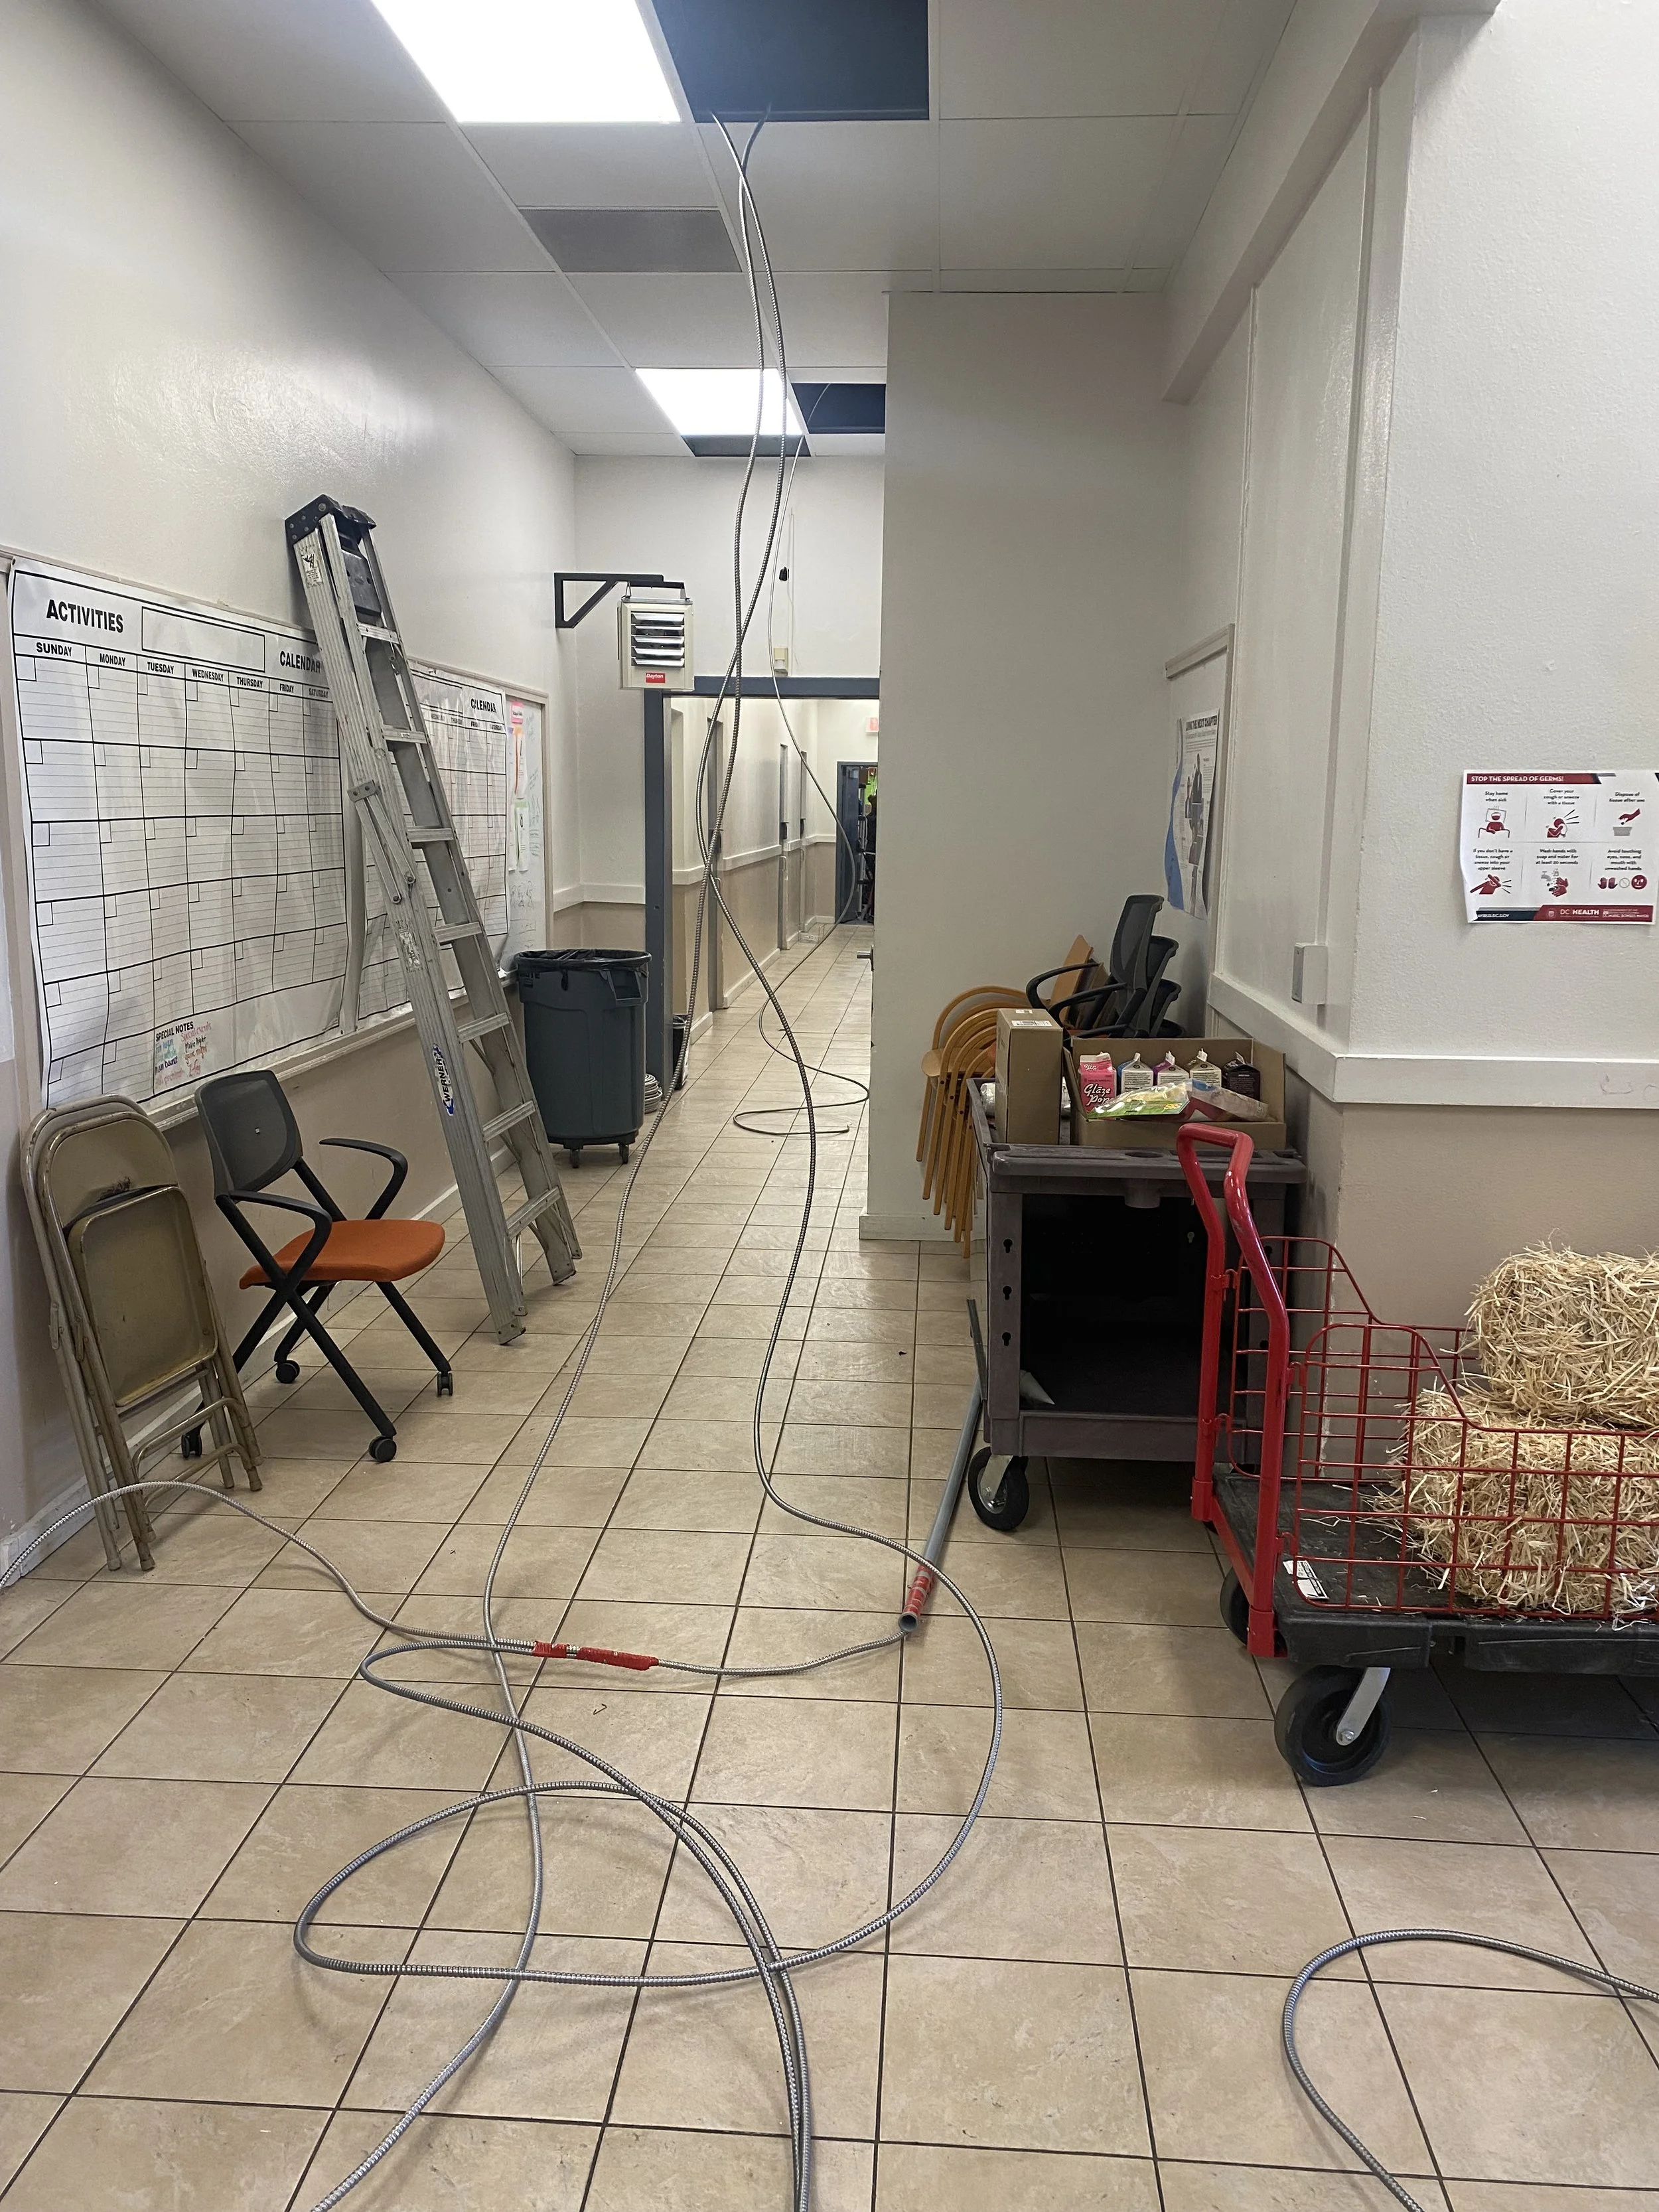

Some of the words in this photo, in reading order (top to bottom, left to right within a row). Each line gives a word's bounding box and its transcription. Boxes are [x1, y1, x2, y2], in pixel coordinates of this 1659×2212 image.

[46, 599, 123, 633] ACTIVITIES
[279, 650, 321, 674] CALENDAR
[36, 642, 72, 657] SUNDAY
[99, 652, 126, 667] MONDAY
[147, 661, 175, 674] TUESDAY
[192, 668, 224, 682] WEDNESDAY
[236, 676, 263, 688] THURSDAY
[279, 683, 295, 694] FRIDAY
[309, 688, 328, 698] SATURDAY
[156, 1027, 175, 1042] SPECIAL
[175, 1021, 194, 1034] NOTES
[437, 1058, 451, 1102] WERNER
[1086, 1094, 1110, 1106] Pop
